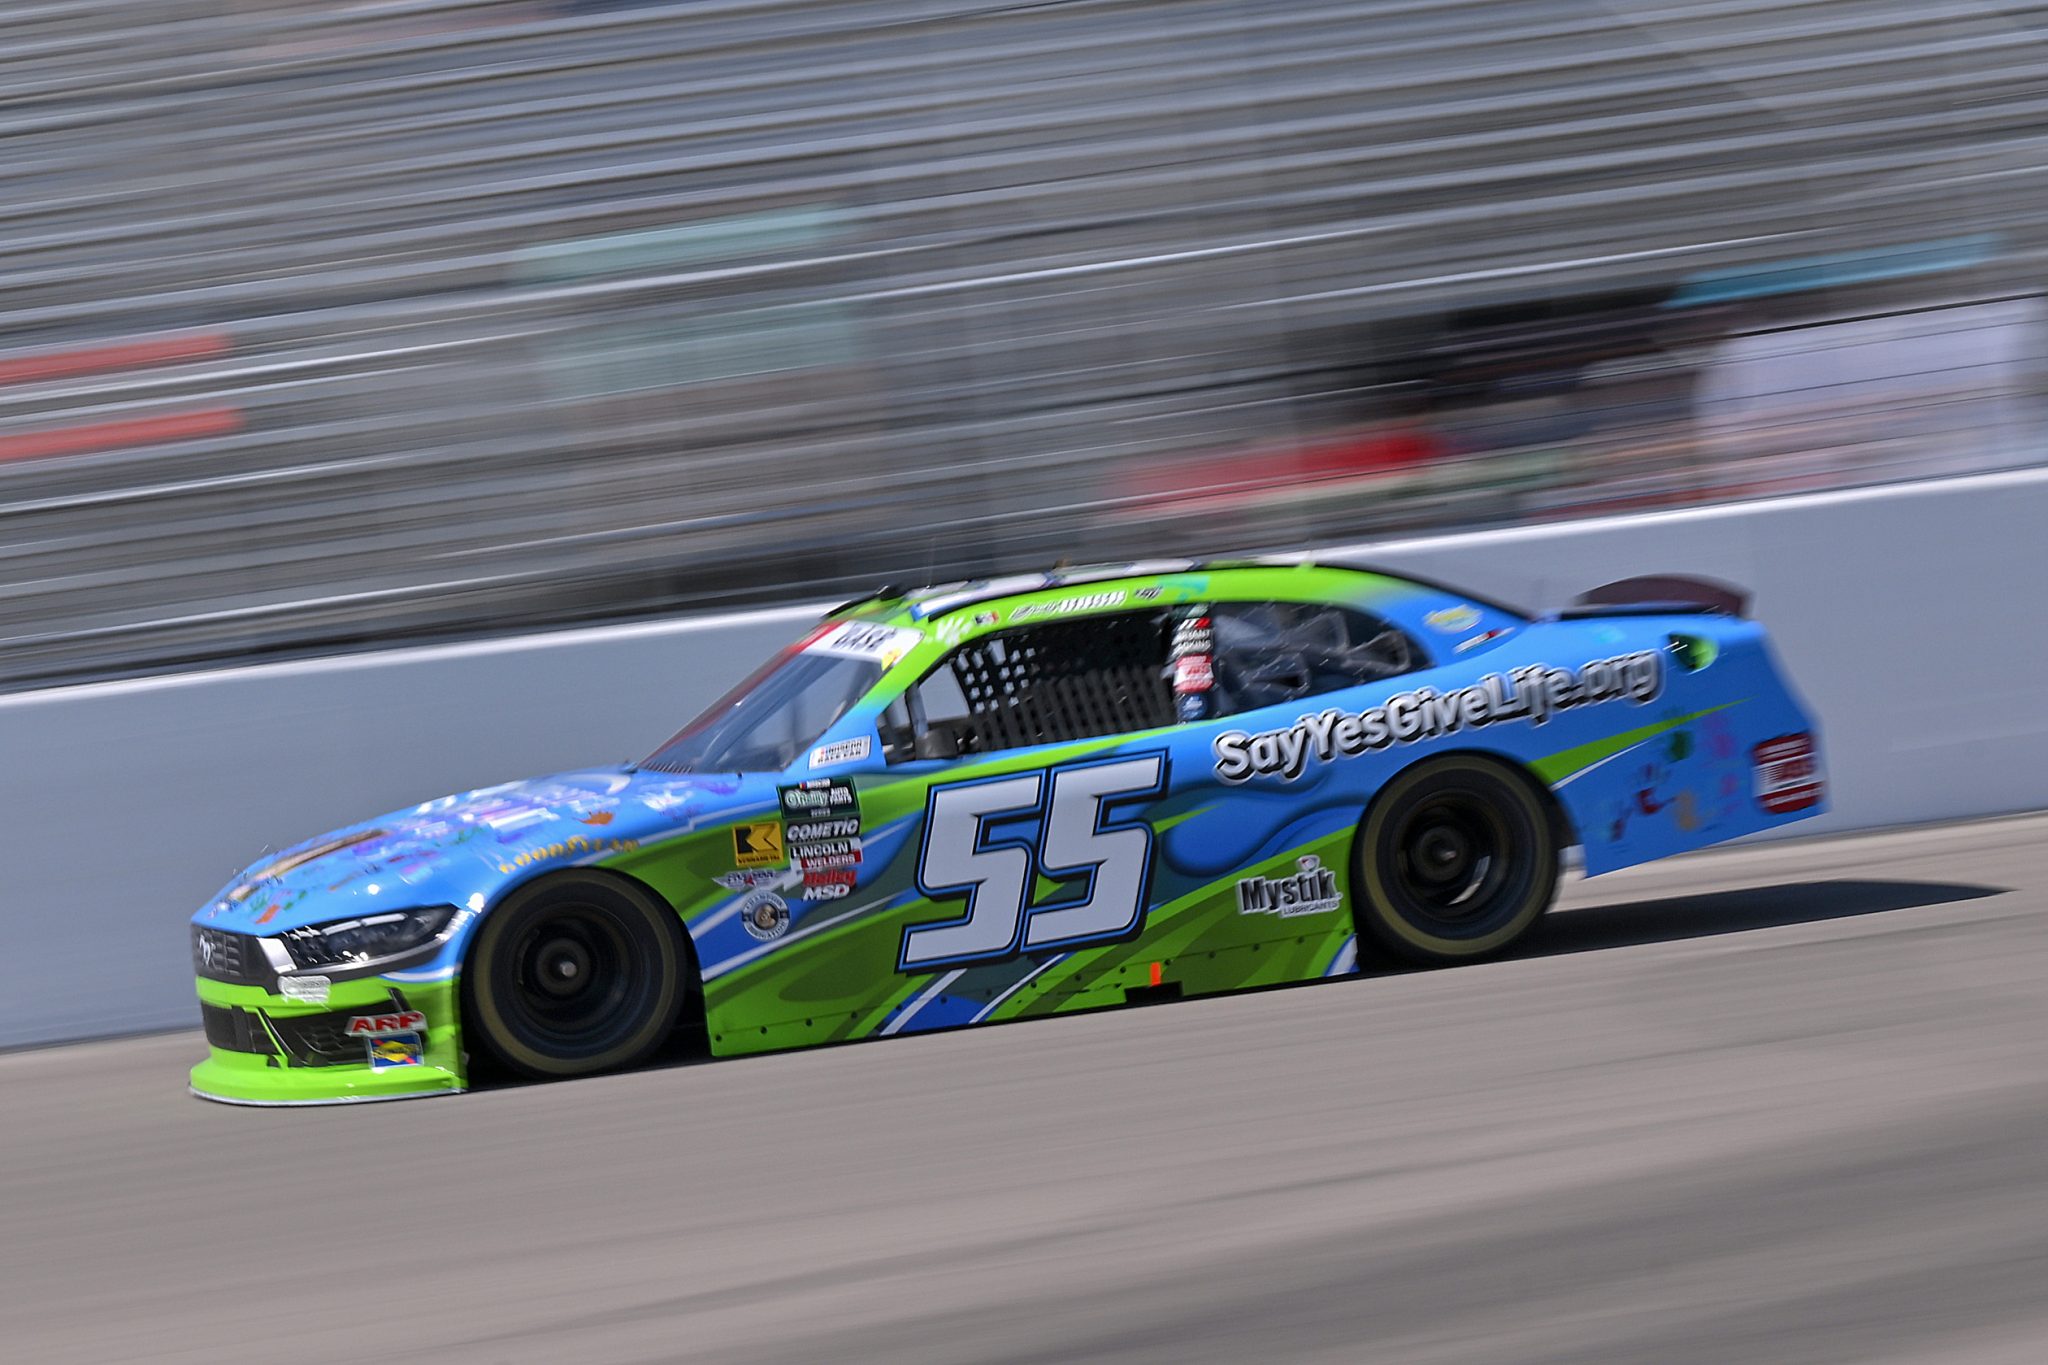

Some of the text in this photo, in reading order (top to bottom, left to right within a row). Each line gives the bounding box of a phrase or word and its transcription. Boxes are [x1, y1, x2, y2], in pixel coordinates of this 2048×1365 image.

[1214, 650, 1664, 784] SayYesGiveLife.org
[787, 819, 859, 841] COMETIC
[793, 841, 849, 858] LINCOLN
[806, 853, 856, 867] WELDERS
[897, 748, 1169, 973] 55
[803, 883, 850, 901] MSD
[1238, 857, 1338, 912] Mystik
[352, 1012, 422, 1033] ARP
